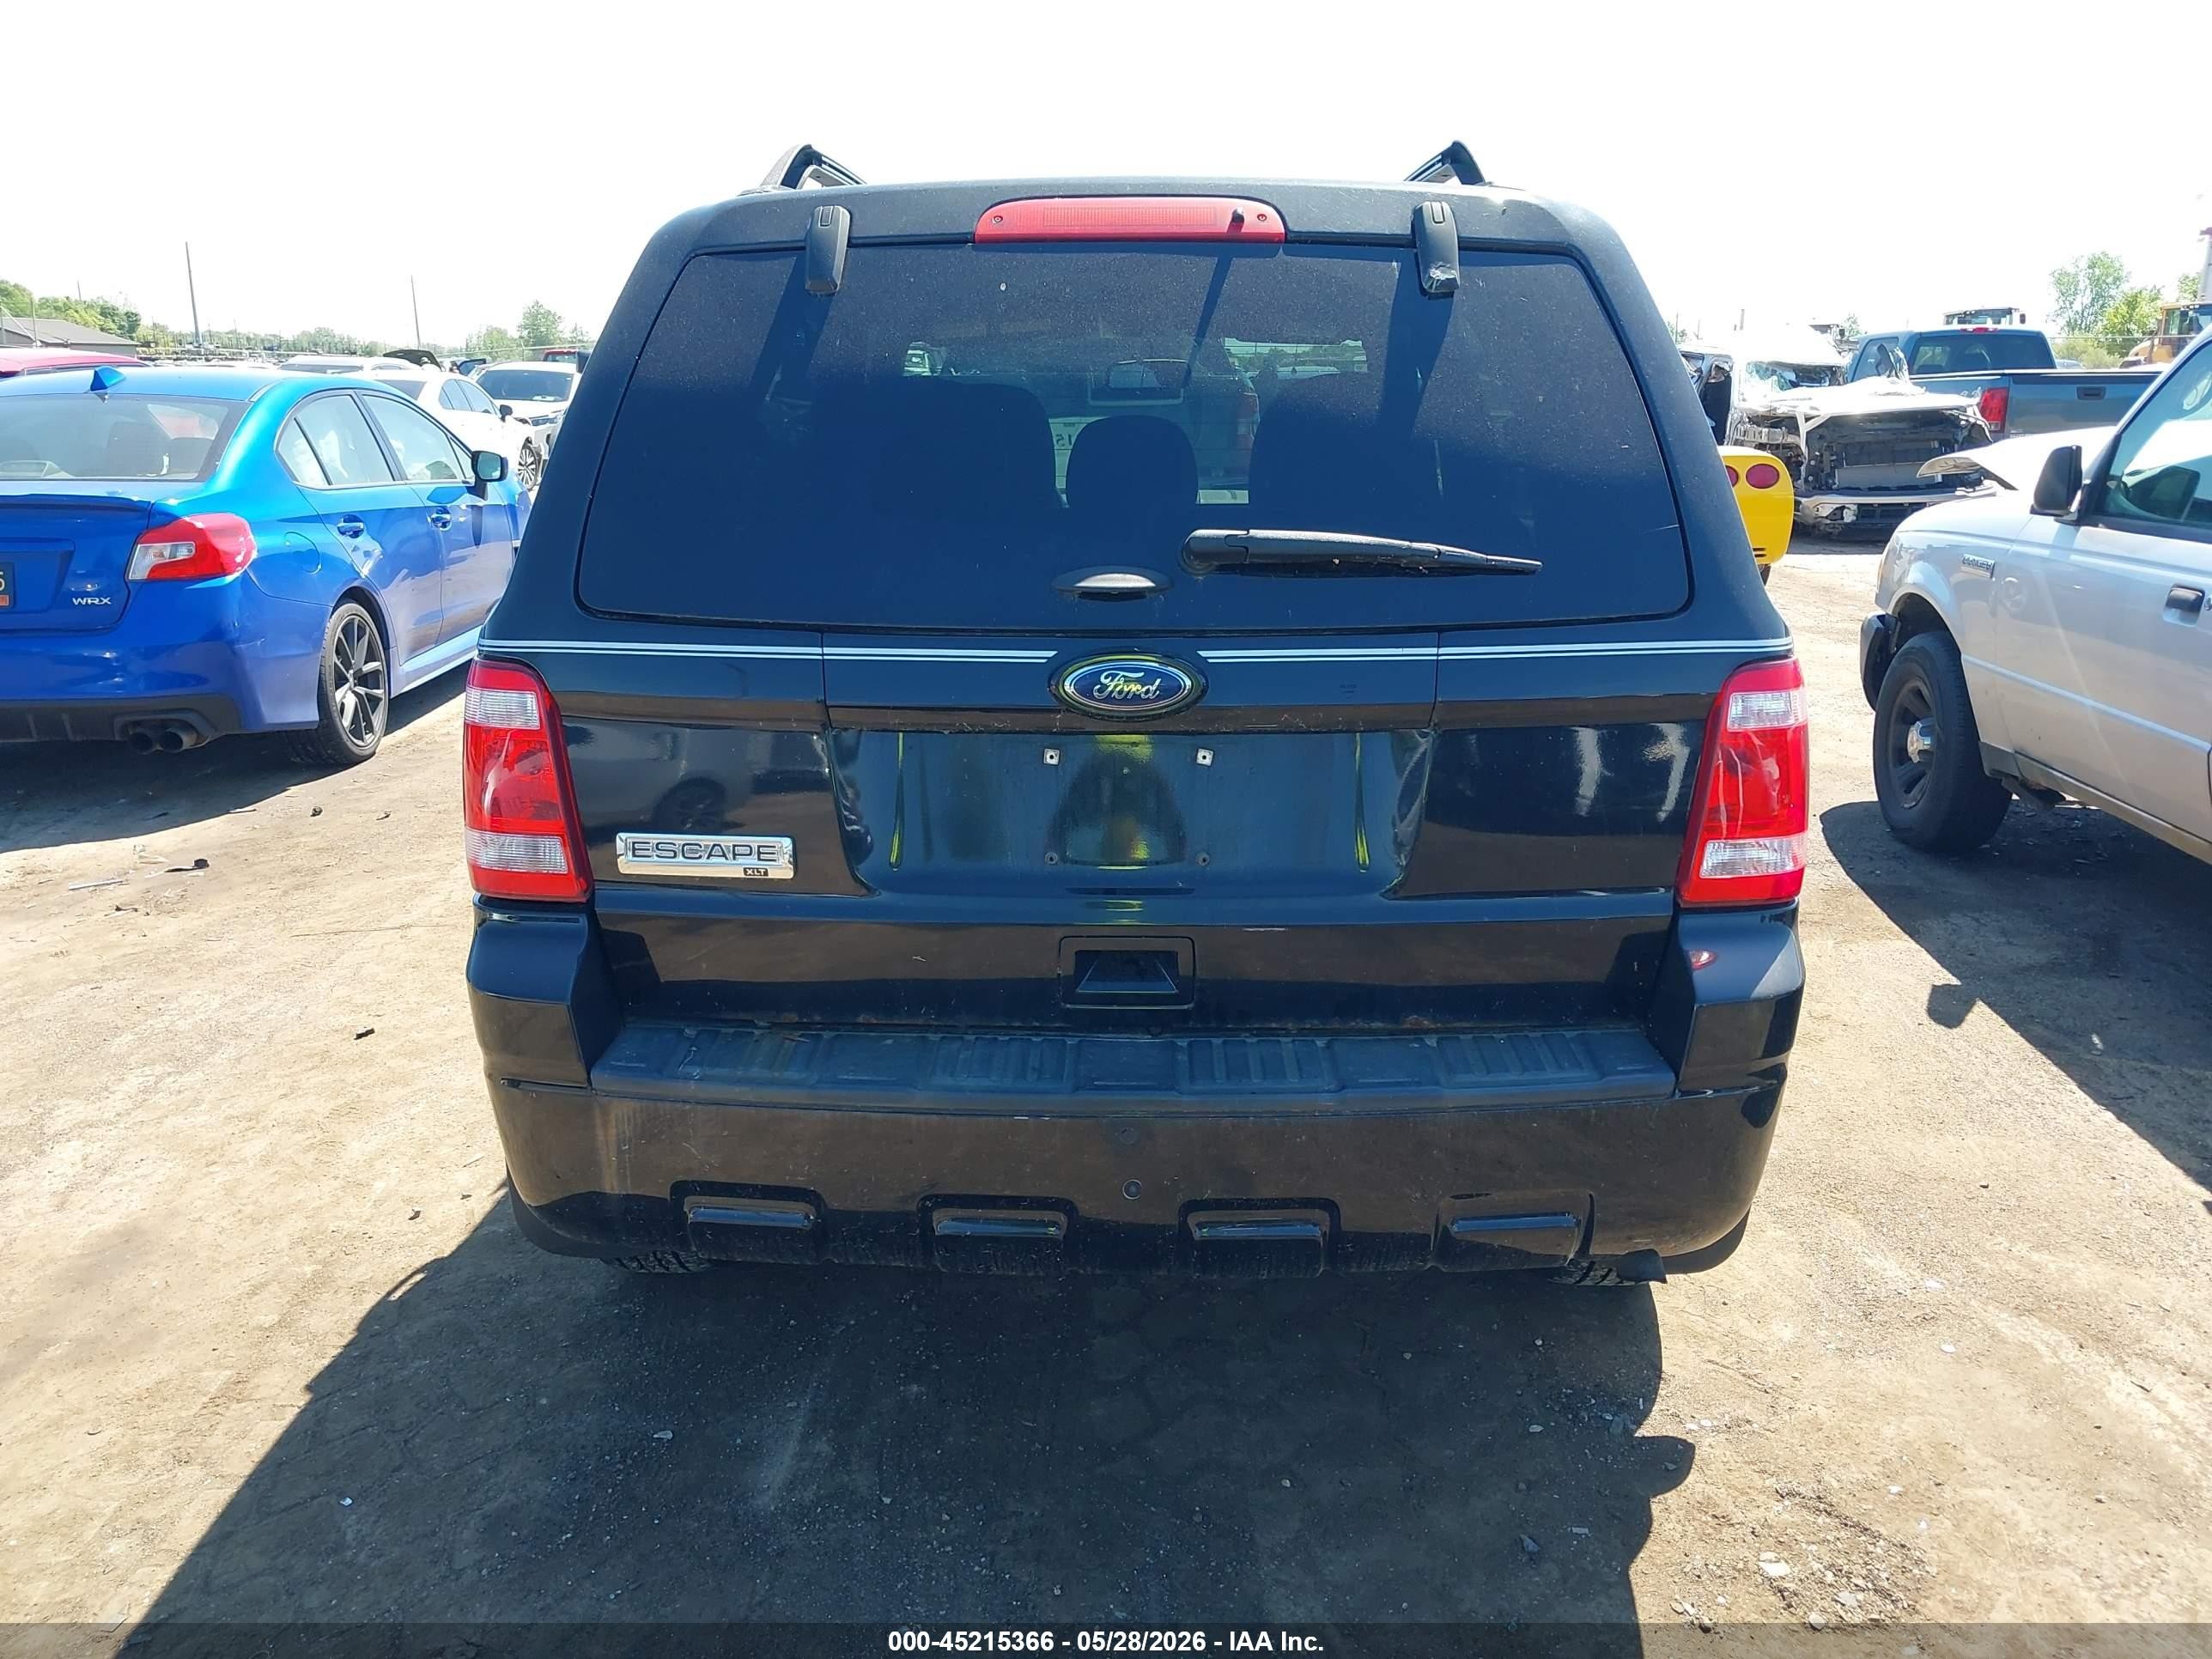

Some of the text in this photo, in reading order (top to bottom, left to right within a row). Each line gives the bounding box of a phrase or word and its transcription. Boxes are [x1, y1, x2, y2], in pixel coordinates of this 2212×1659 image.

[72, 597, 112, 605] WRX
[1092, 670, 1161, 700] Ford
[630, 841, 778, 862] ESCAPE
[745, 868, 766, 877] XLT
